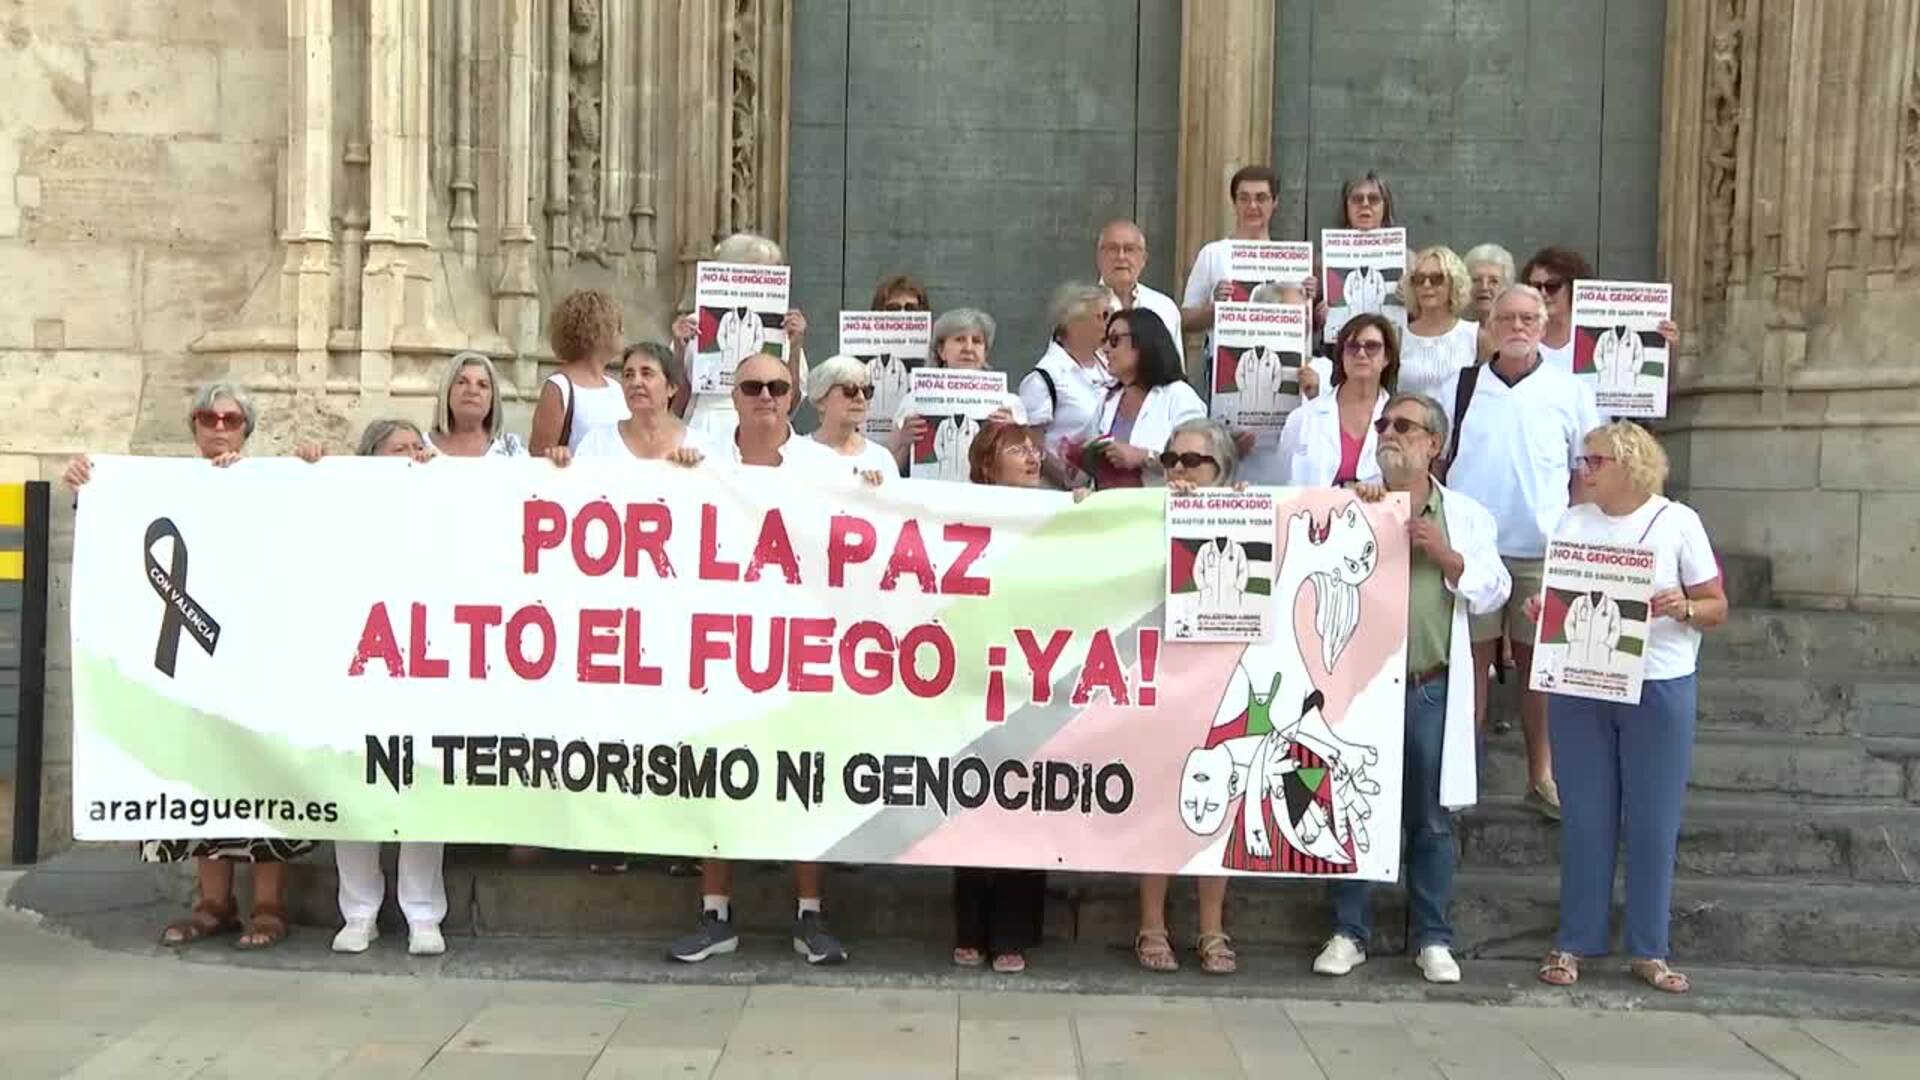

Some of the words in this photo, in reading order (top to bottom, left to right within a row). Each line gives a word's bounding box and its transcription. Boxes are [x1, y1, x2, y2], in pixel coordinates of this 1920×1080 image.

[732, 275, 787, 286] GENOCIDIO!
[1609, 293, 1668, 304] GENOCIDIO!
[947, 381, 1004, 392] GENOCIDIO!
[1170, 499, 1190, 510] ¡NO
[1192, 499, 1204, 509] AL
[1207, 499, 1272, 510] GENOCIDIO!
[523, 500, 673, 578] POR
[700, 504, 800, 584] LA
[828, 516, 991, 595] PAZ
[1550, 549, 1570, 560] ¡NO
[1572, 551, 1584, 561] AL
[1587, 552, 1653, 568] GENOCIDIO!
[150, 567, 172, 593] CON
[171, 589, 216, 644] VALENCIA
[349, 602, 557, 678] ALTO
[577, 609, 662, 685] EL
[689, 613, 956, 698] FUEGO
[986, 628, 1158, 722] ¡YA!
[364, 735, 415, 792] NI
[431, 735, 760, 799] TERRORISMO
[775, 750, 826, 810] NI
[842, 752, 1135, 815] GENOCIDIO
[90, 793, 338, 826] ararlaguerra.es
